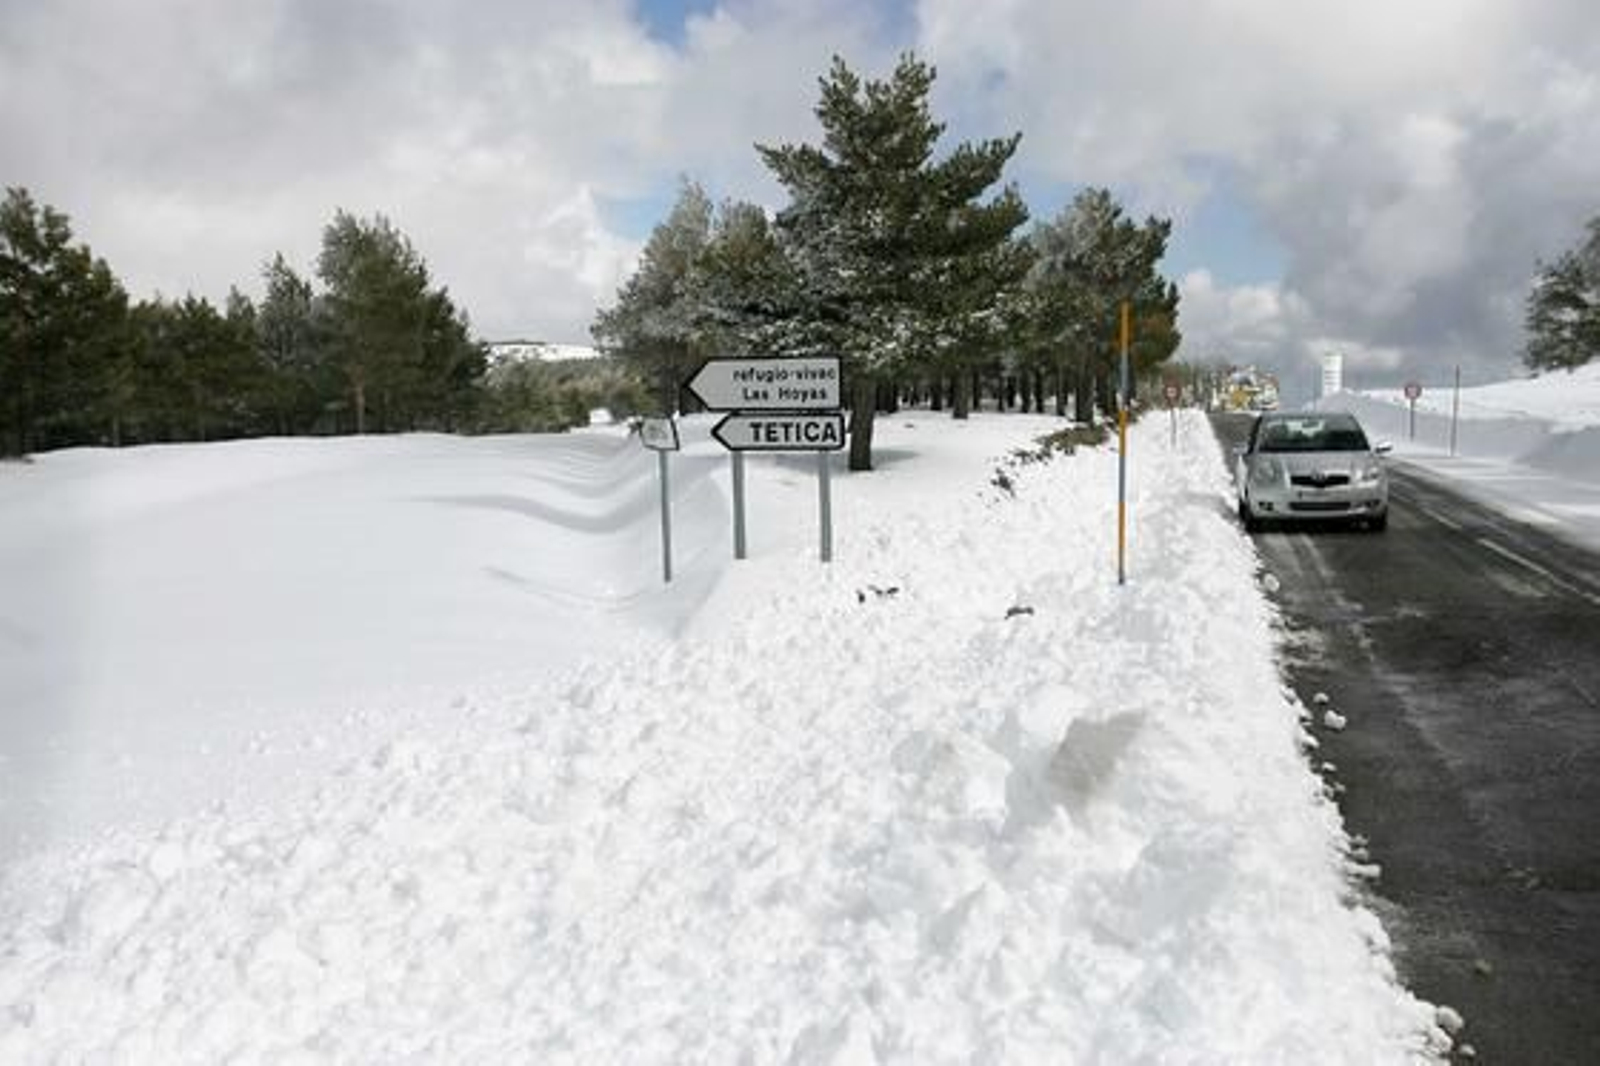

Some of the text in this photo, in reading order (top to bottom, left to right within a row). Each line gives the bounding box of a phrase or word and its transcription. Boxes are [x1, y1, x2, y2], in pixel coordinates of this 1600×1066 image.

[743, 387, 828, 403] Las Hoyas
[749, 421, 838, 443] TETICA
